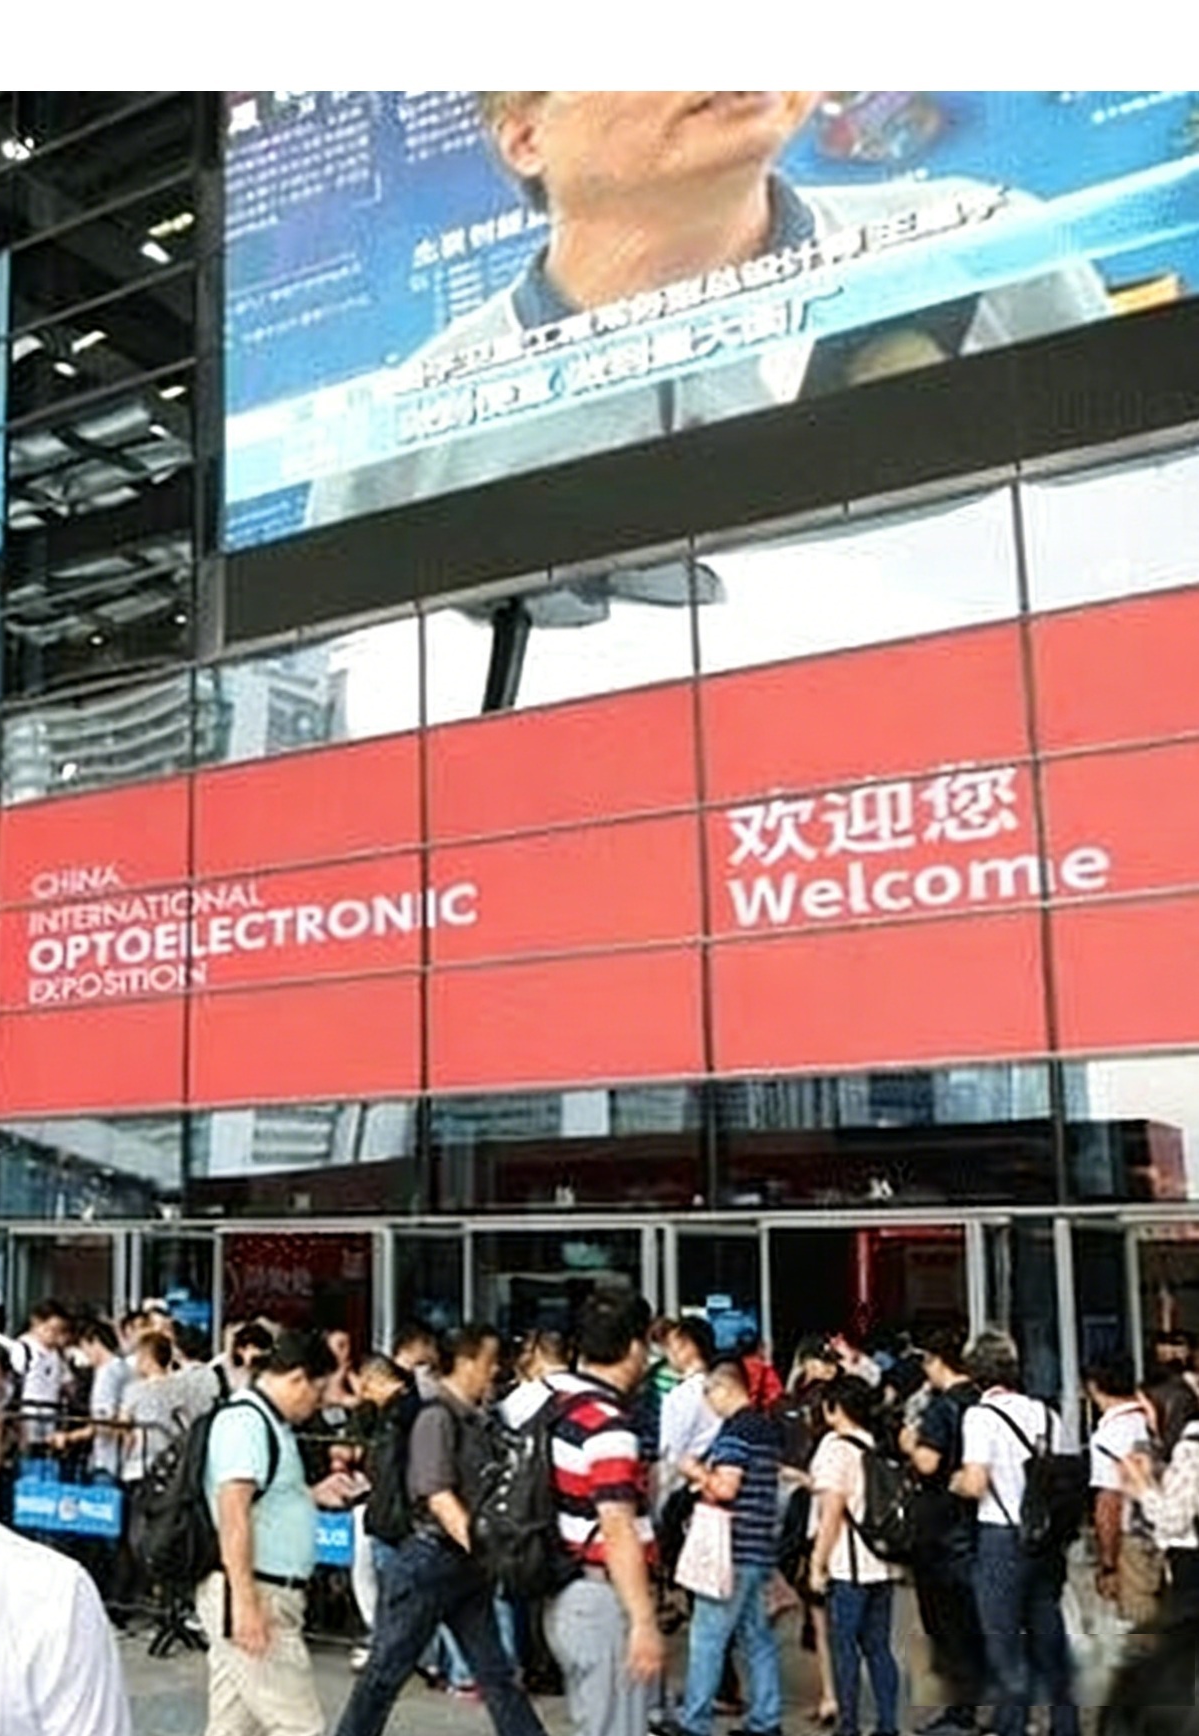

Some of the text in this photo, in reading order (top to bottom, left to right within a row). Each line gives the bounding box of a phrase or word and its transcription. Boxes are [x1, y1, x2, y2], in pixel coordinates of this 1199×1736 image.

[725, 761, 1019, 866] 欢迎您
[28, 883, 262, 937] INTERNATIONAL
[30, 865, 122, 900] CHINA
[726, 844, 1110, 927] Welcome
[28, 883, 478, 973] OPTOELECTRONIC
[28, 961, 207, 1006] EXPOSITION
